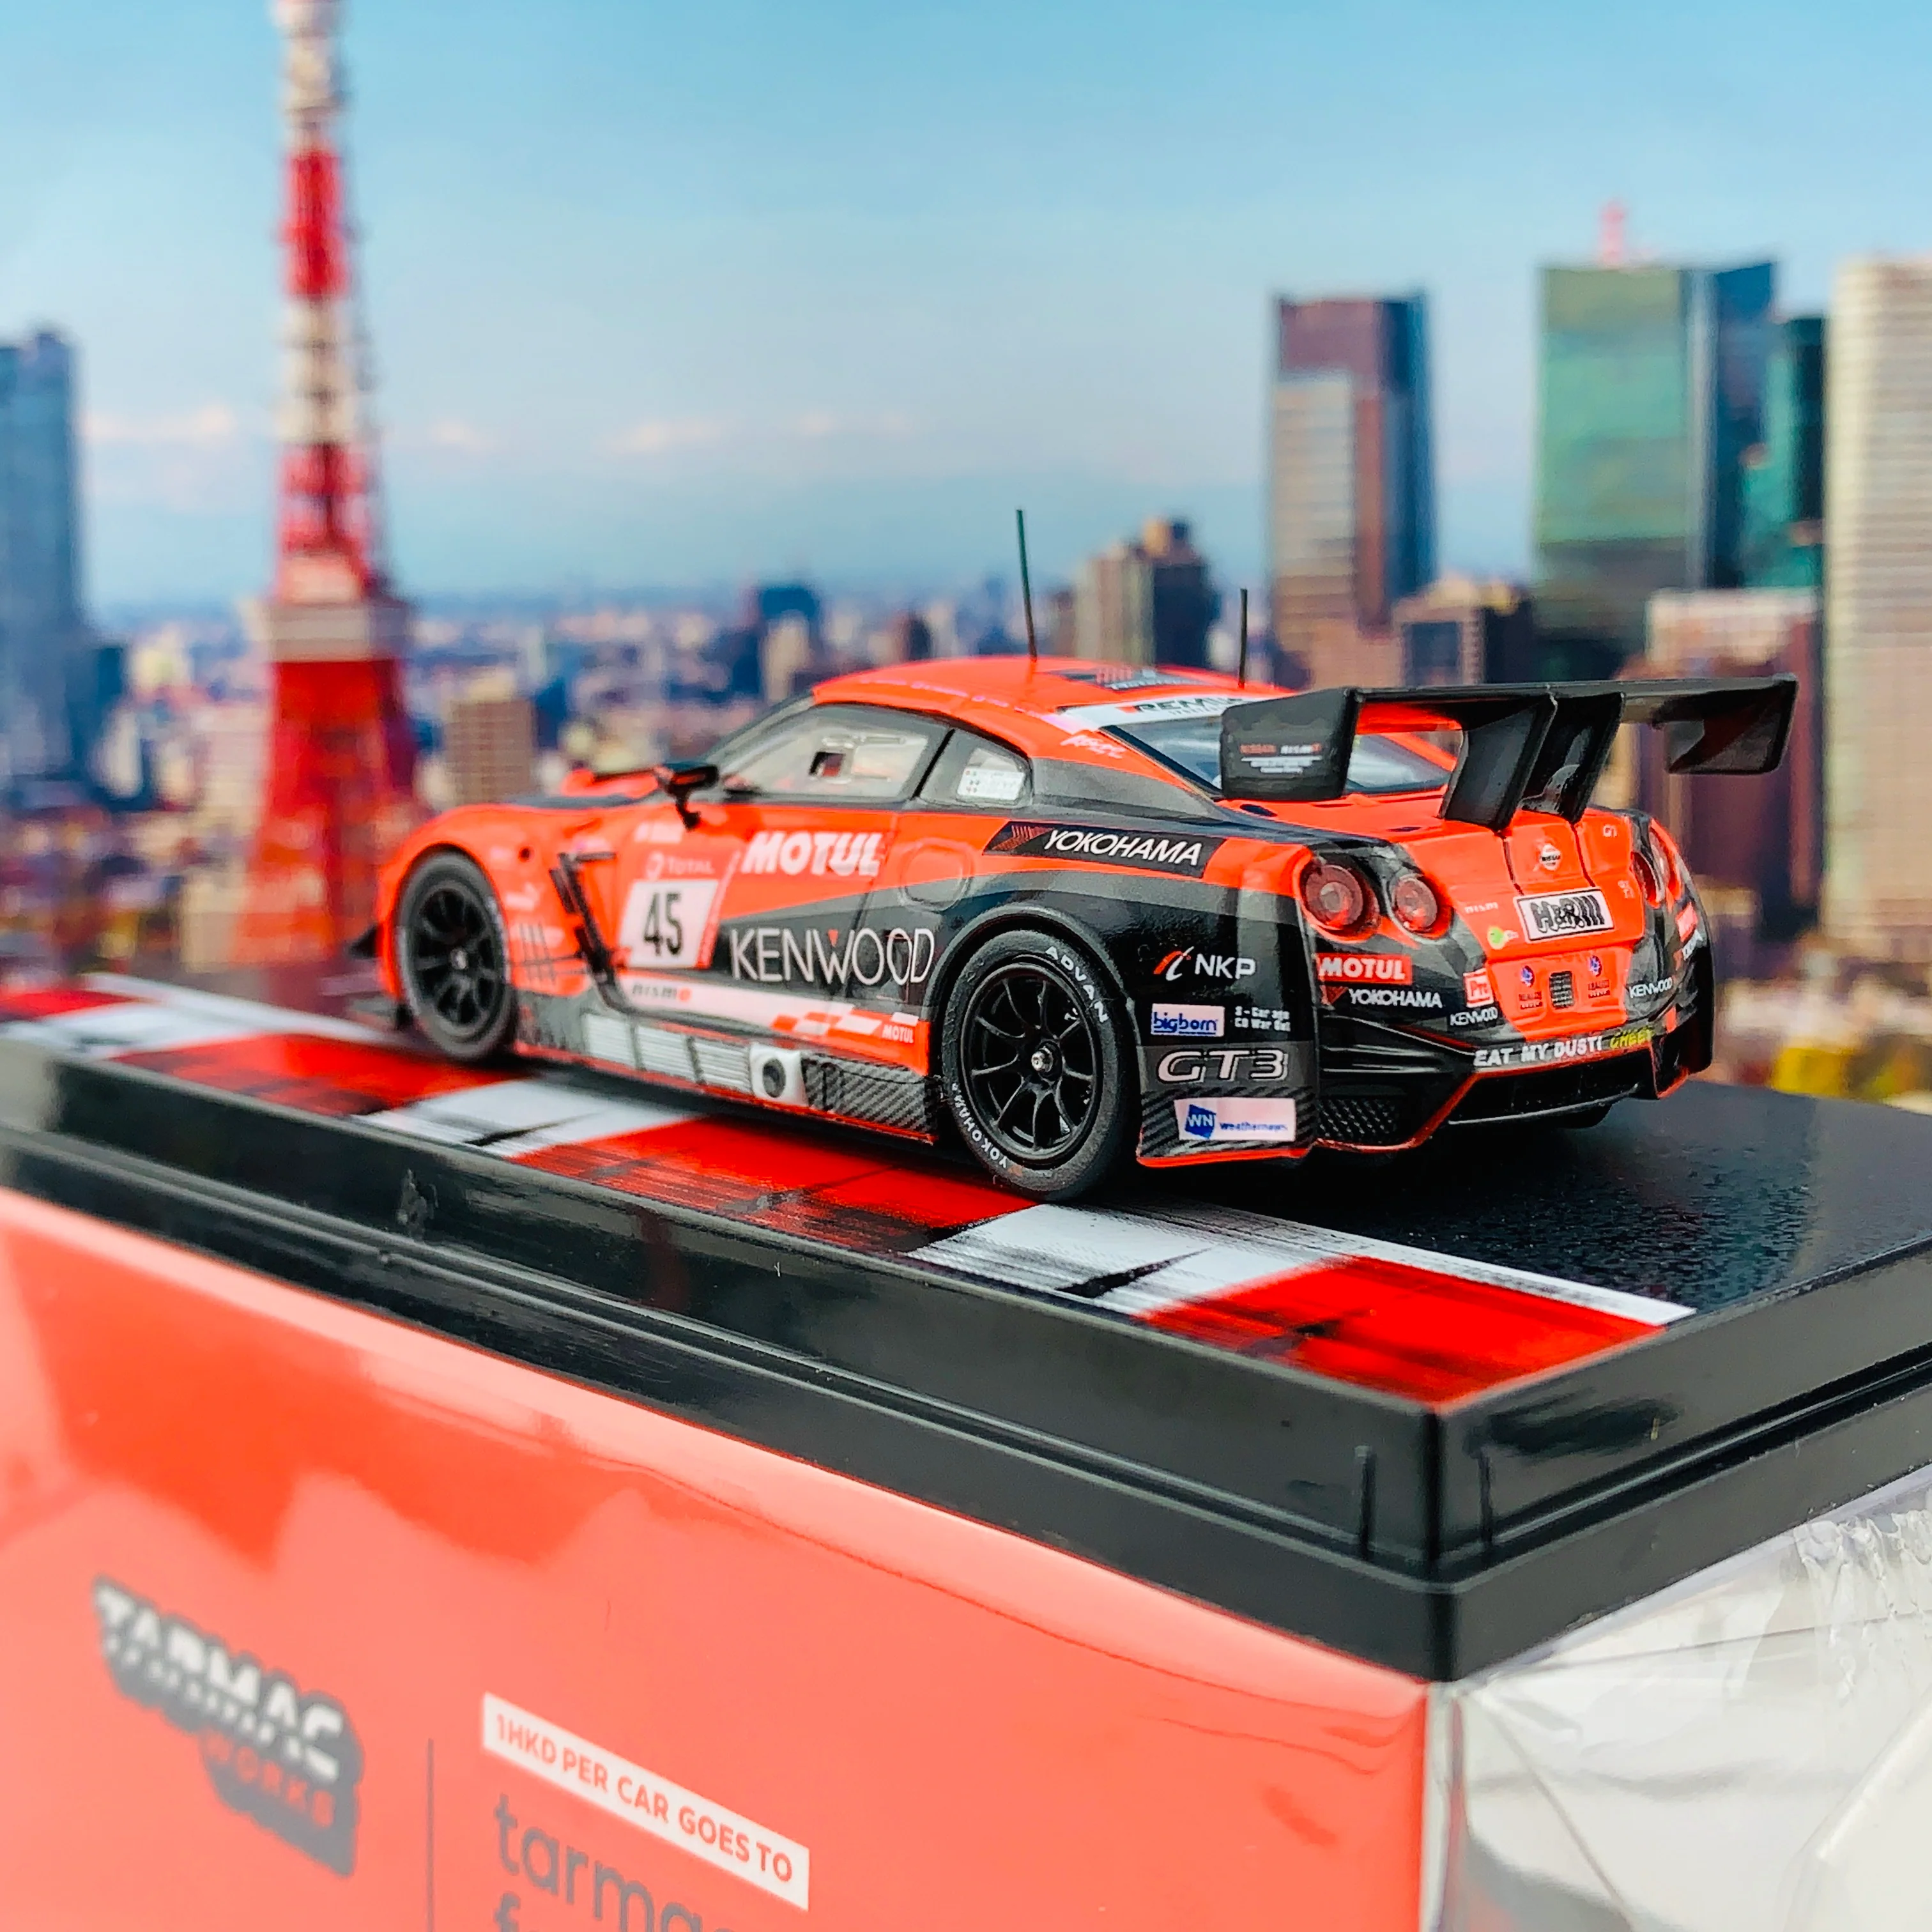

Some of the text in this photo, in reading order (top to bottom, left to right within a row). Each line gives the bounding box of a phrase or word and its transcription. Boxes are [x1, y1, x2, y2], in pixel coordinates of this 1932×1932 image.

[742, 832, 883, 876] MOTUL
[1043, 829, 1203, 866] YOKOHAMA
[644, 893, 682, 956] 45
[730, 928, 935, 985] KENWOOD
[1195, 953, 1255, 979] NKP
[1319, 957, 1406, 979] MOTUL
[1046, 946, 1108, 1023] ADVAN
[1349, 989, 1443, 1008] YOKOHAMA
[1630, 977, 1672, 998] KENWOOD
[1450, 1007, 1498, 1025] KENWOOD
[881, 1024, 914, 1043] MOTUL
[1156, 1048, 1288, 1084] GT3
[1473, 1048, 1514, 1066] EAT
[1521, 1043, 1549, 1062] MY
[1188, 1114, 1213, 1128] WN
[95, 1583, 344, 1784] TARMAC
[496, 1713, 793, 1883] 1HKD PER CAR GOES TO
